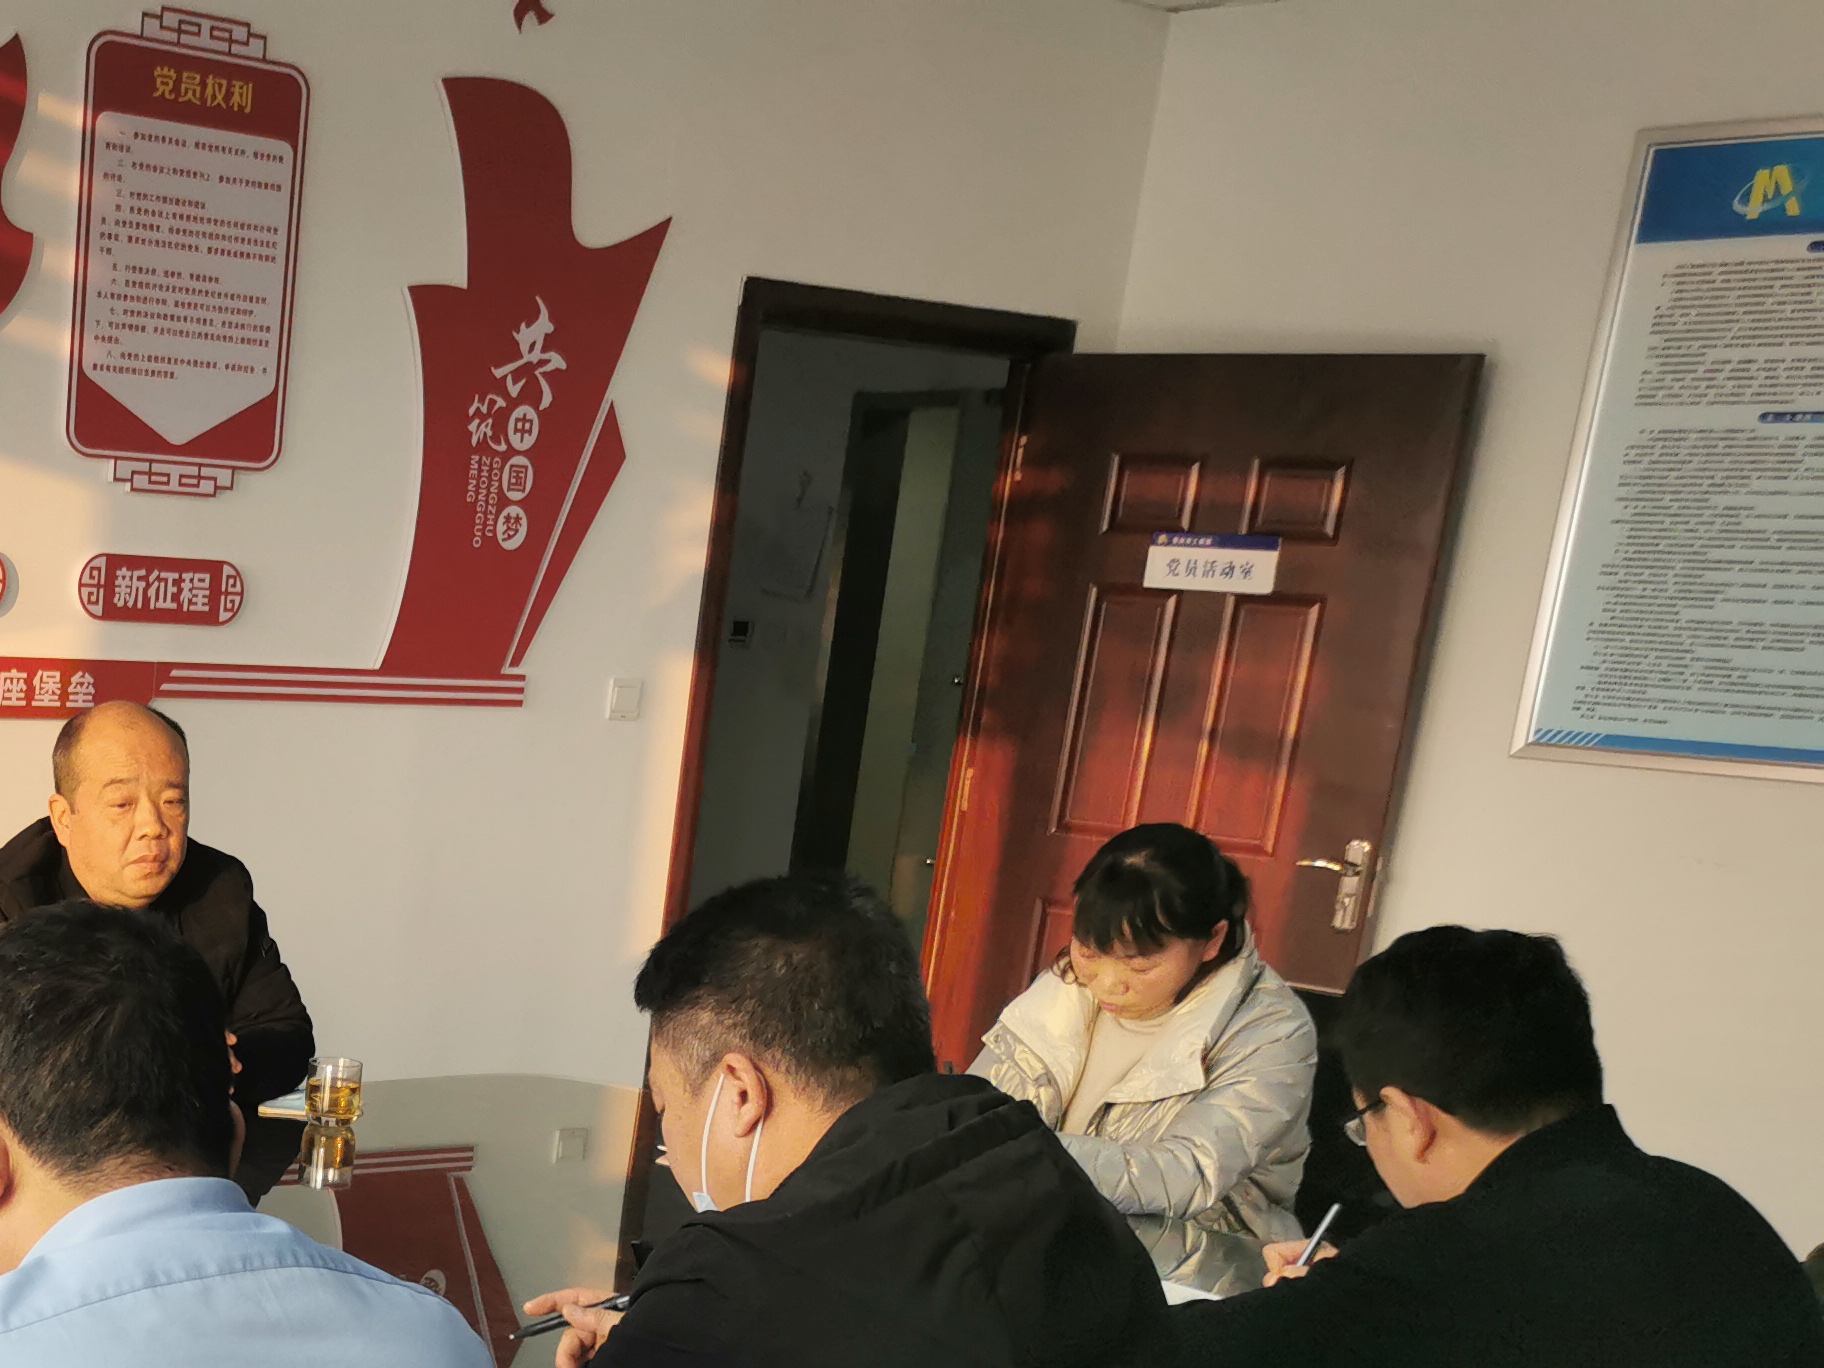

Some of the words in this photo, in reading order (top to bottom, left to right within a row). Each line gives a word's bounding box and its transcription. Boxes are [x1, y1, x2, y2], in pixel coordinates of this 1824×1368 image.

[152, 65, 254, 114] 党员权利
[467, 295, 567, 453] 共筑
[466, 455, 480, 503] MENG
[472, 456, 491, 548] ZHONGGUO
[484, 456, 502, 537] GONGZHU
[500, 412, 534, 543] 中国梦
[112, 566, 212, 613] 新征程
[1165, 558, 1255, 581] 党员活动室
